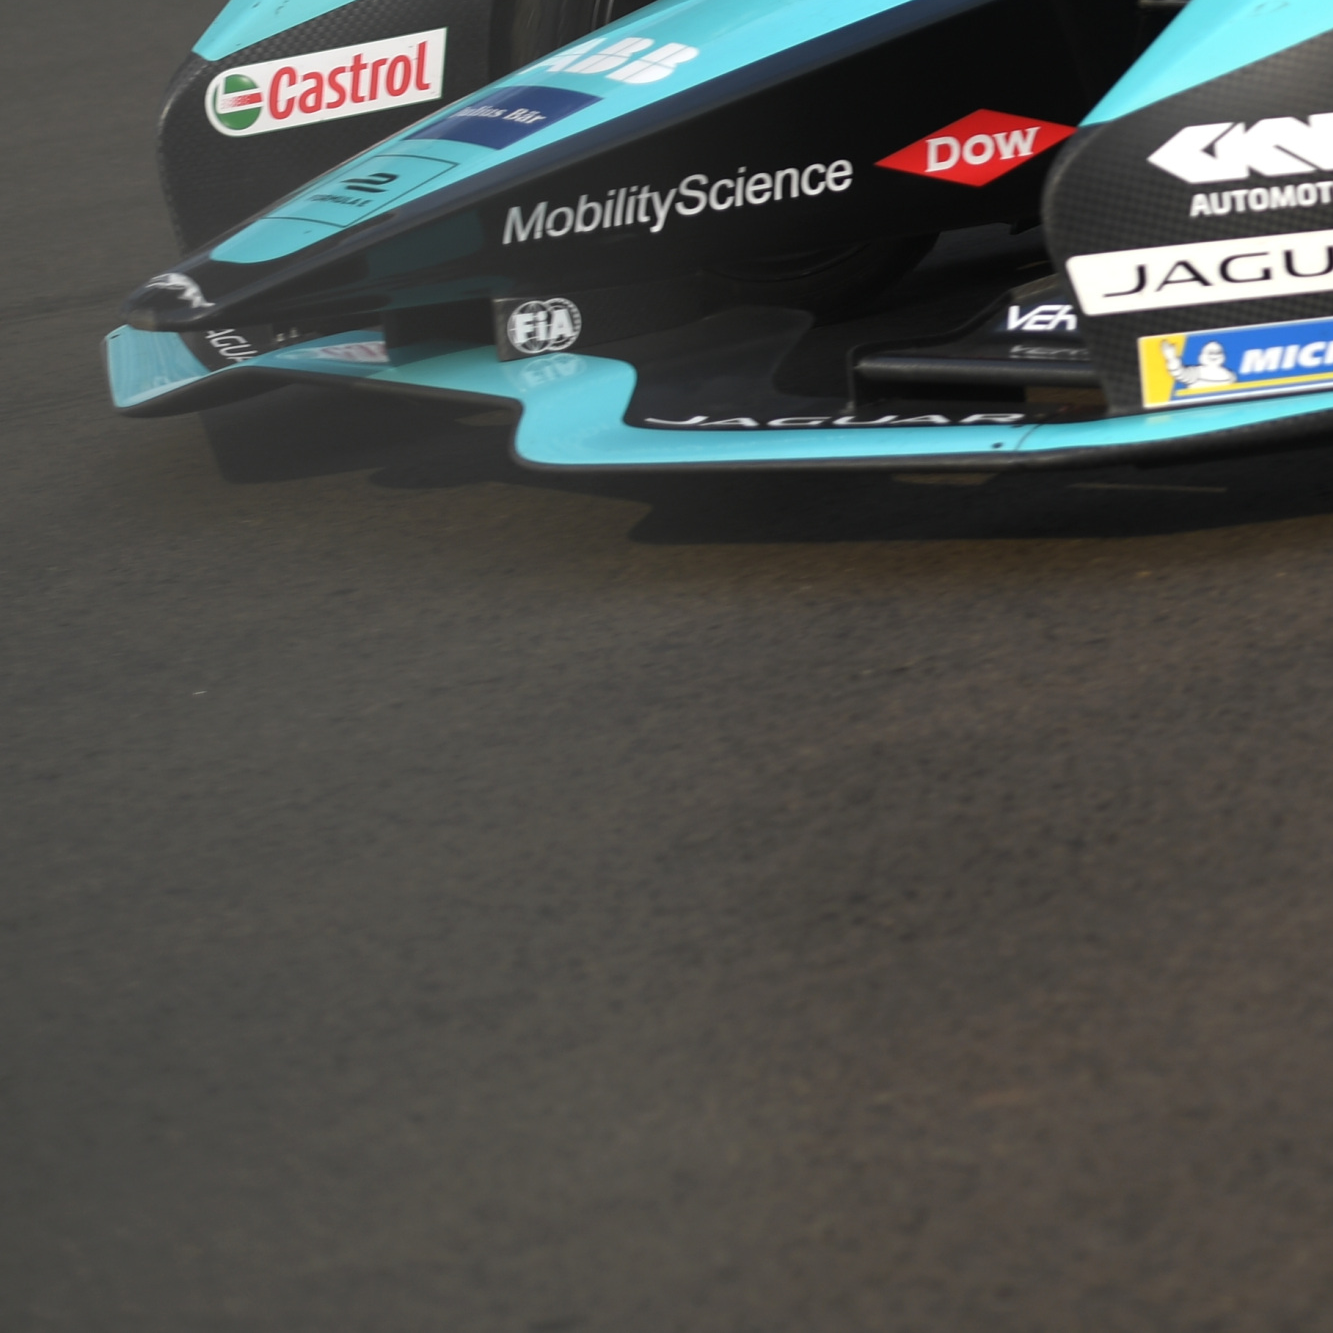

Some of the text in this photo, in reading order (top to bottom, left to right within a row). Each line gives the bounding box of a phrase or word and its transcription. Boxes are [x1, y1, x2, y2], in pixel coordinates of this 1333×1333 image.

[268, 40, 431, 121] Castrol
[518, 36, 700, 84] ABB
[502, 108, 547, 124] Bär
[502, 159, 854, 245] MobilityScience
[512, 305, 577, 346] FIA
[644, 412, 1028, 429] JAGUAR
